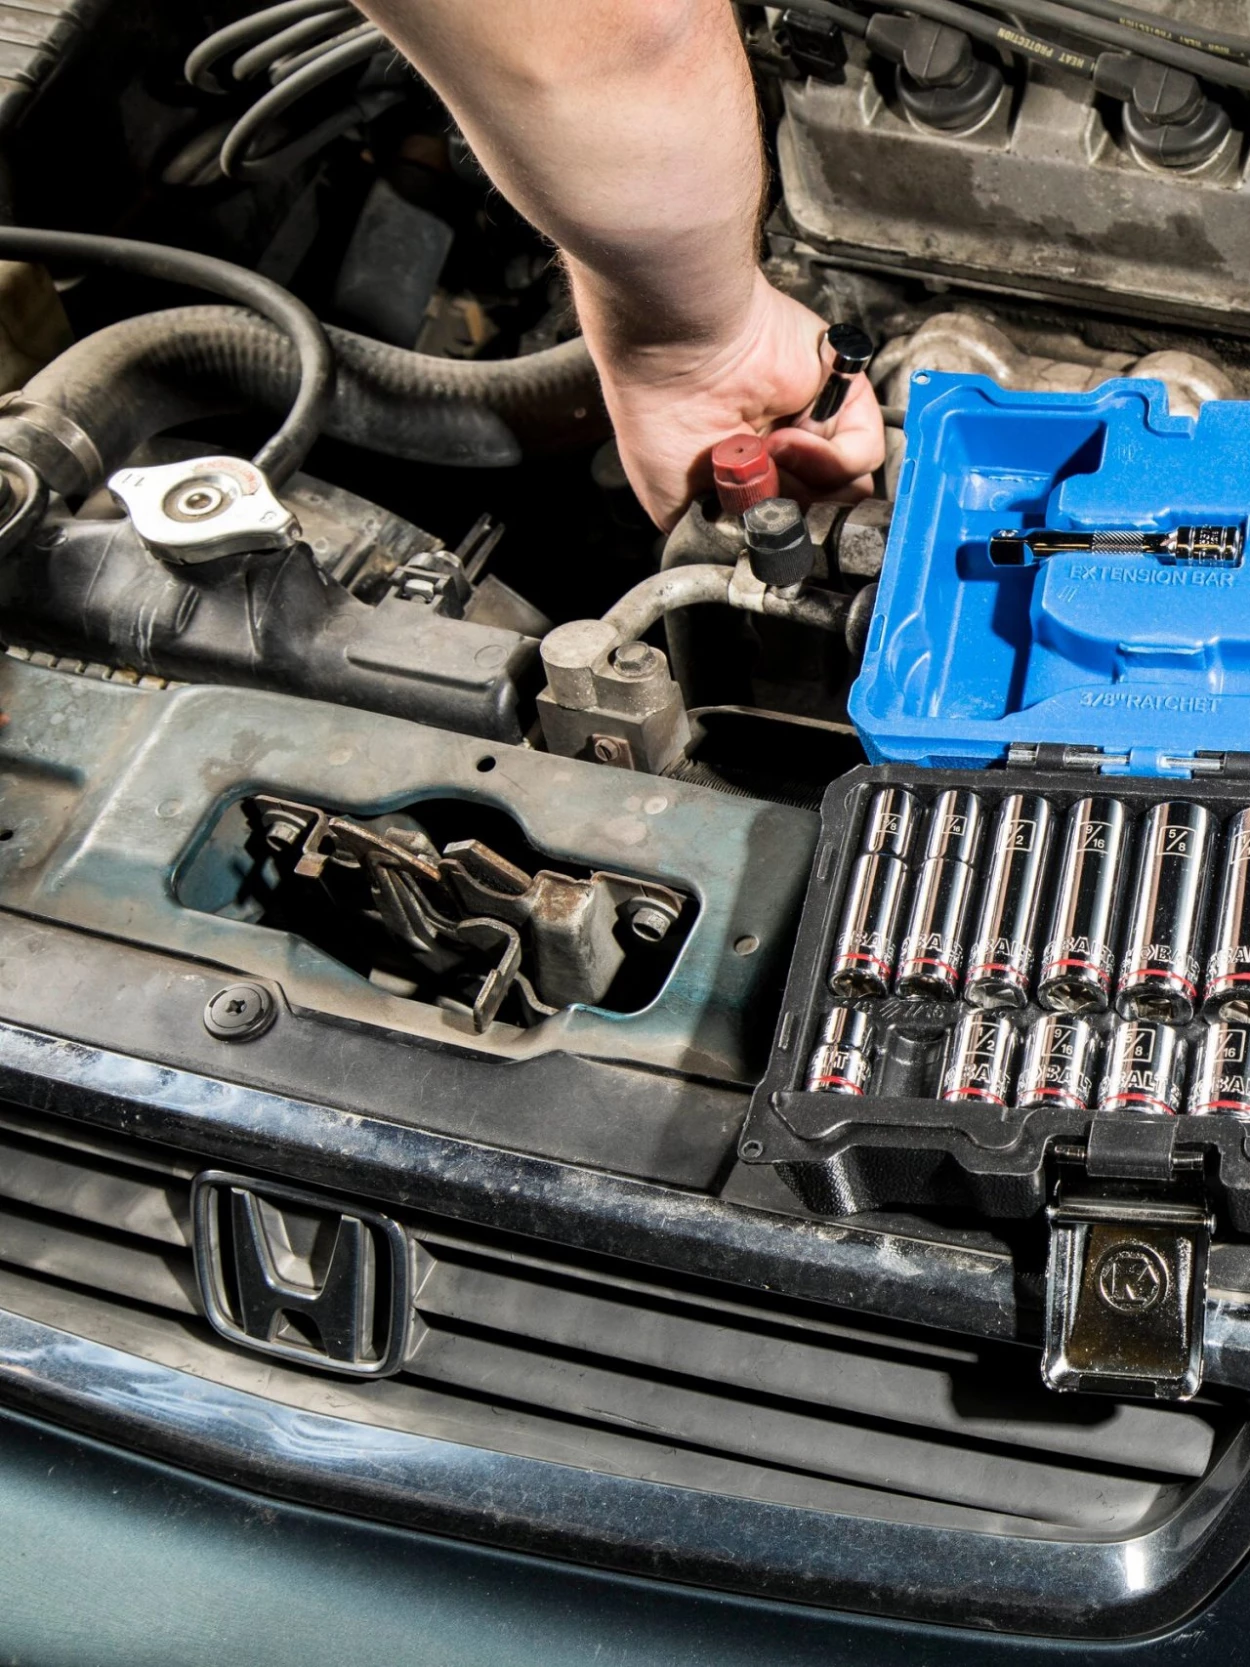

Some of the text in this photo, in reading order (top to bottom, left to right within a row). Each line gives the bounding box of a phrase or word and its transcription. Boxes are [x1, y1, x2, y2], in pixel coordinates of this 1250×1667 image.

[997, 27, 1055, 58] PROTECTION
[1070, 565, 1235, 588] EXTENSION BAR
[1126, 692, 1221, 713] RATCHET
[1082, 825, 1106, 848] 9/16
[1166, 829, 1188, 851] 5/8
[974, 1027, 996, 1051] 1/2
[1051, 1029, 1073, 1054] 9/16
